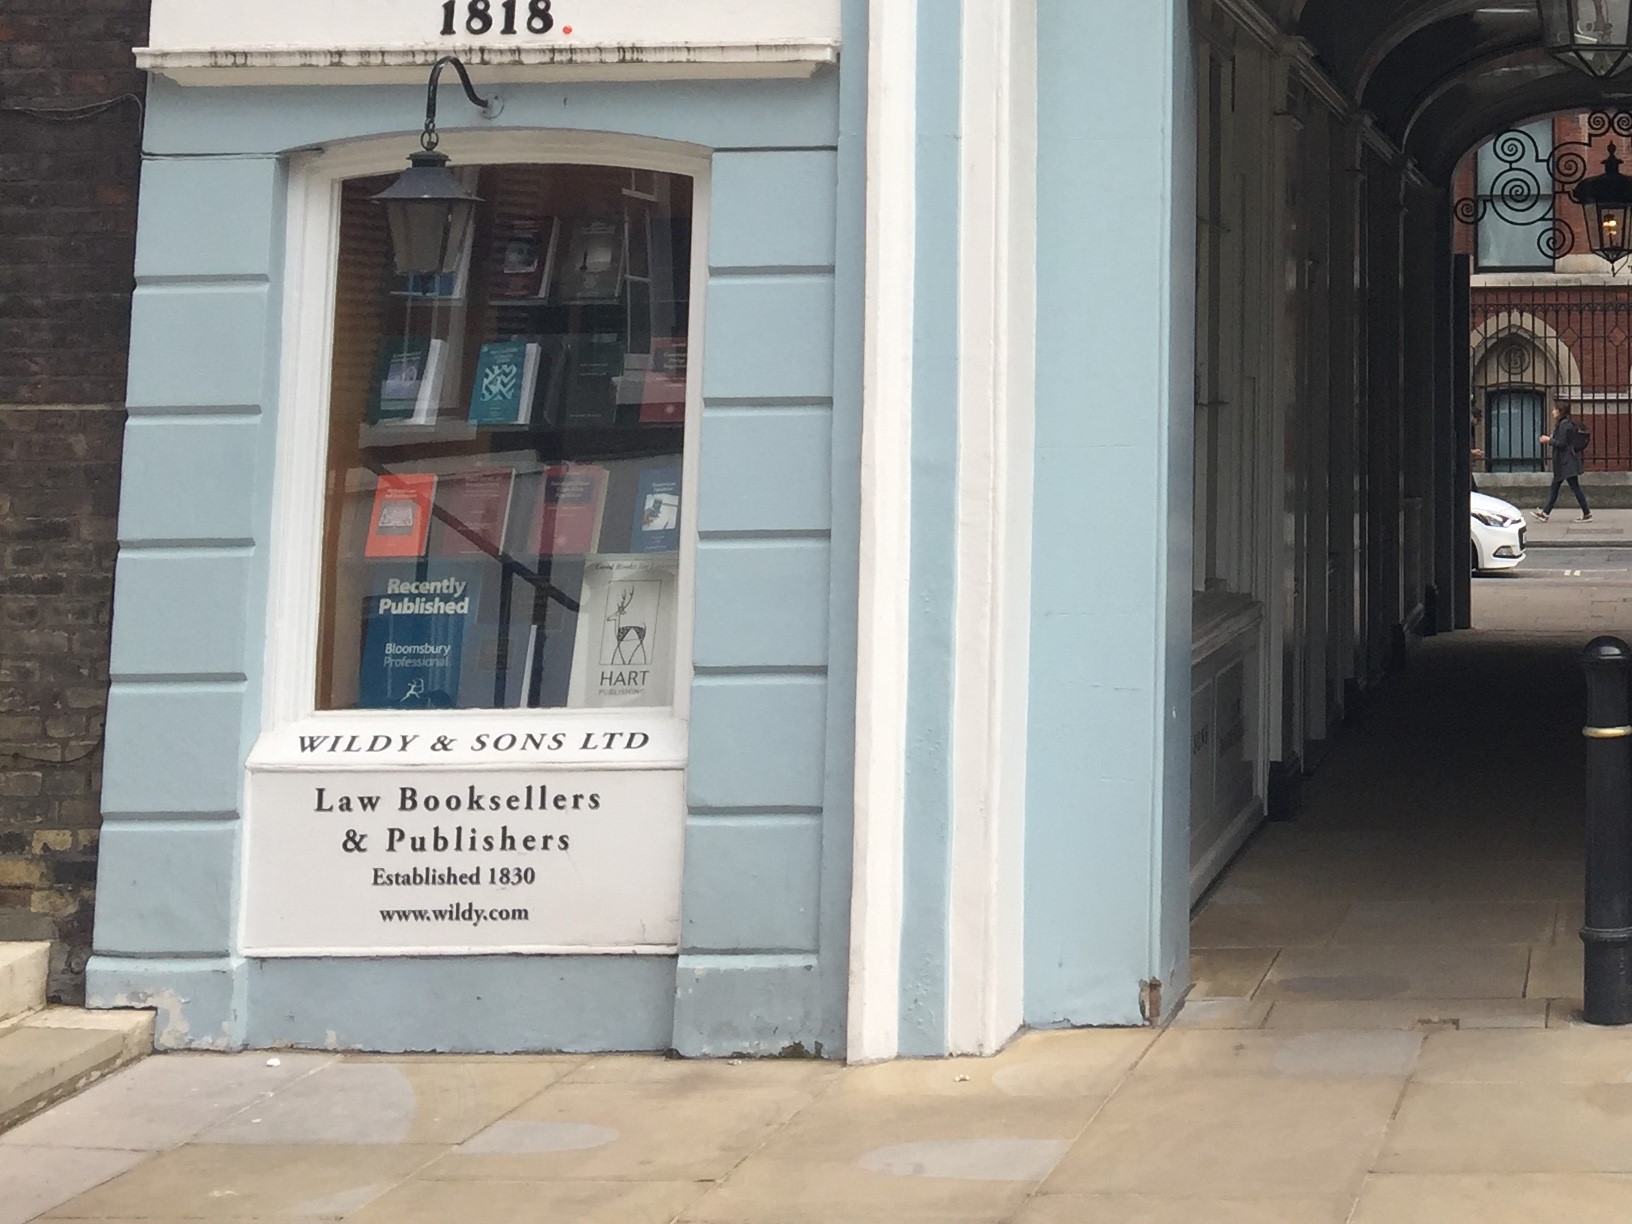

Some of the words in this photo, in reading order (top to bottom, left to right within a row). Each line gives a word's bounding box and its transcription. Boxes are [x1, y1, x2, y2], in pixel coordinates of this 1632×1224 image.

[387, 577, 466, 597] Recently
[379, 598, 469, 614] Published
[385, 643, 451, 656] Bloomsbury
[383, 656, 449, 667] Professional
[600, 671, 649, 686] HART
[300, 735, 418, 752] WILDY
[431, 736, 456, 751] &
[471, 733, 565, 751] SONS
[580, 733, 649, 749] LTD
[316, 788, 380, 812] Law
[399, 785, 599, 811] Booksellers
[342, 829, 367, 852] &
[386, 826, 568, 852] Publishers
[373, 866, 480, 885] Established
[490, 867, 535, 885] 1830
[380, 902, 528, 926] www.wildy.com
